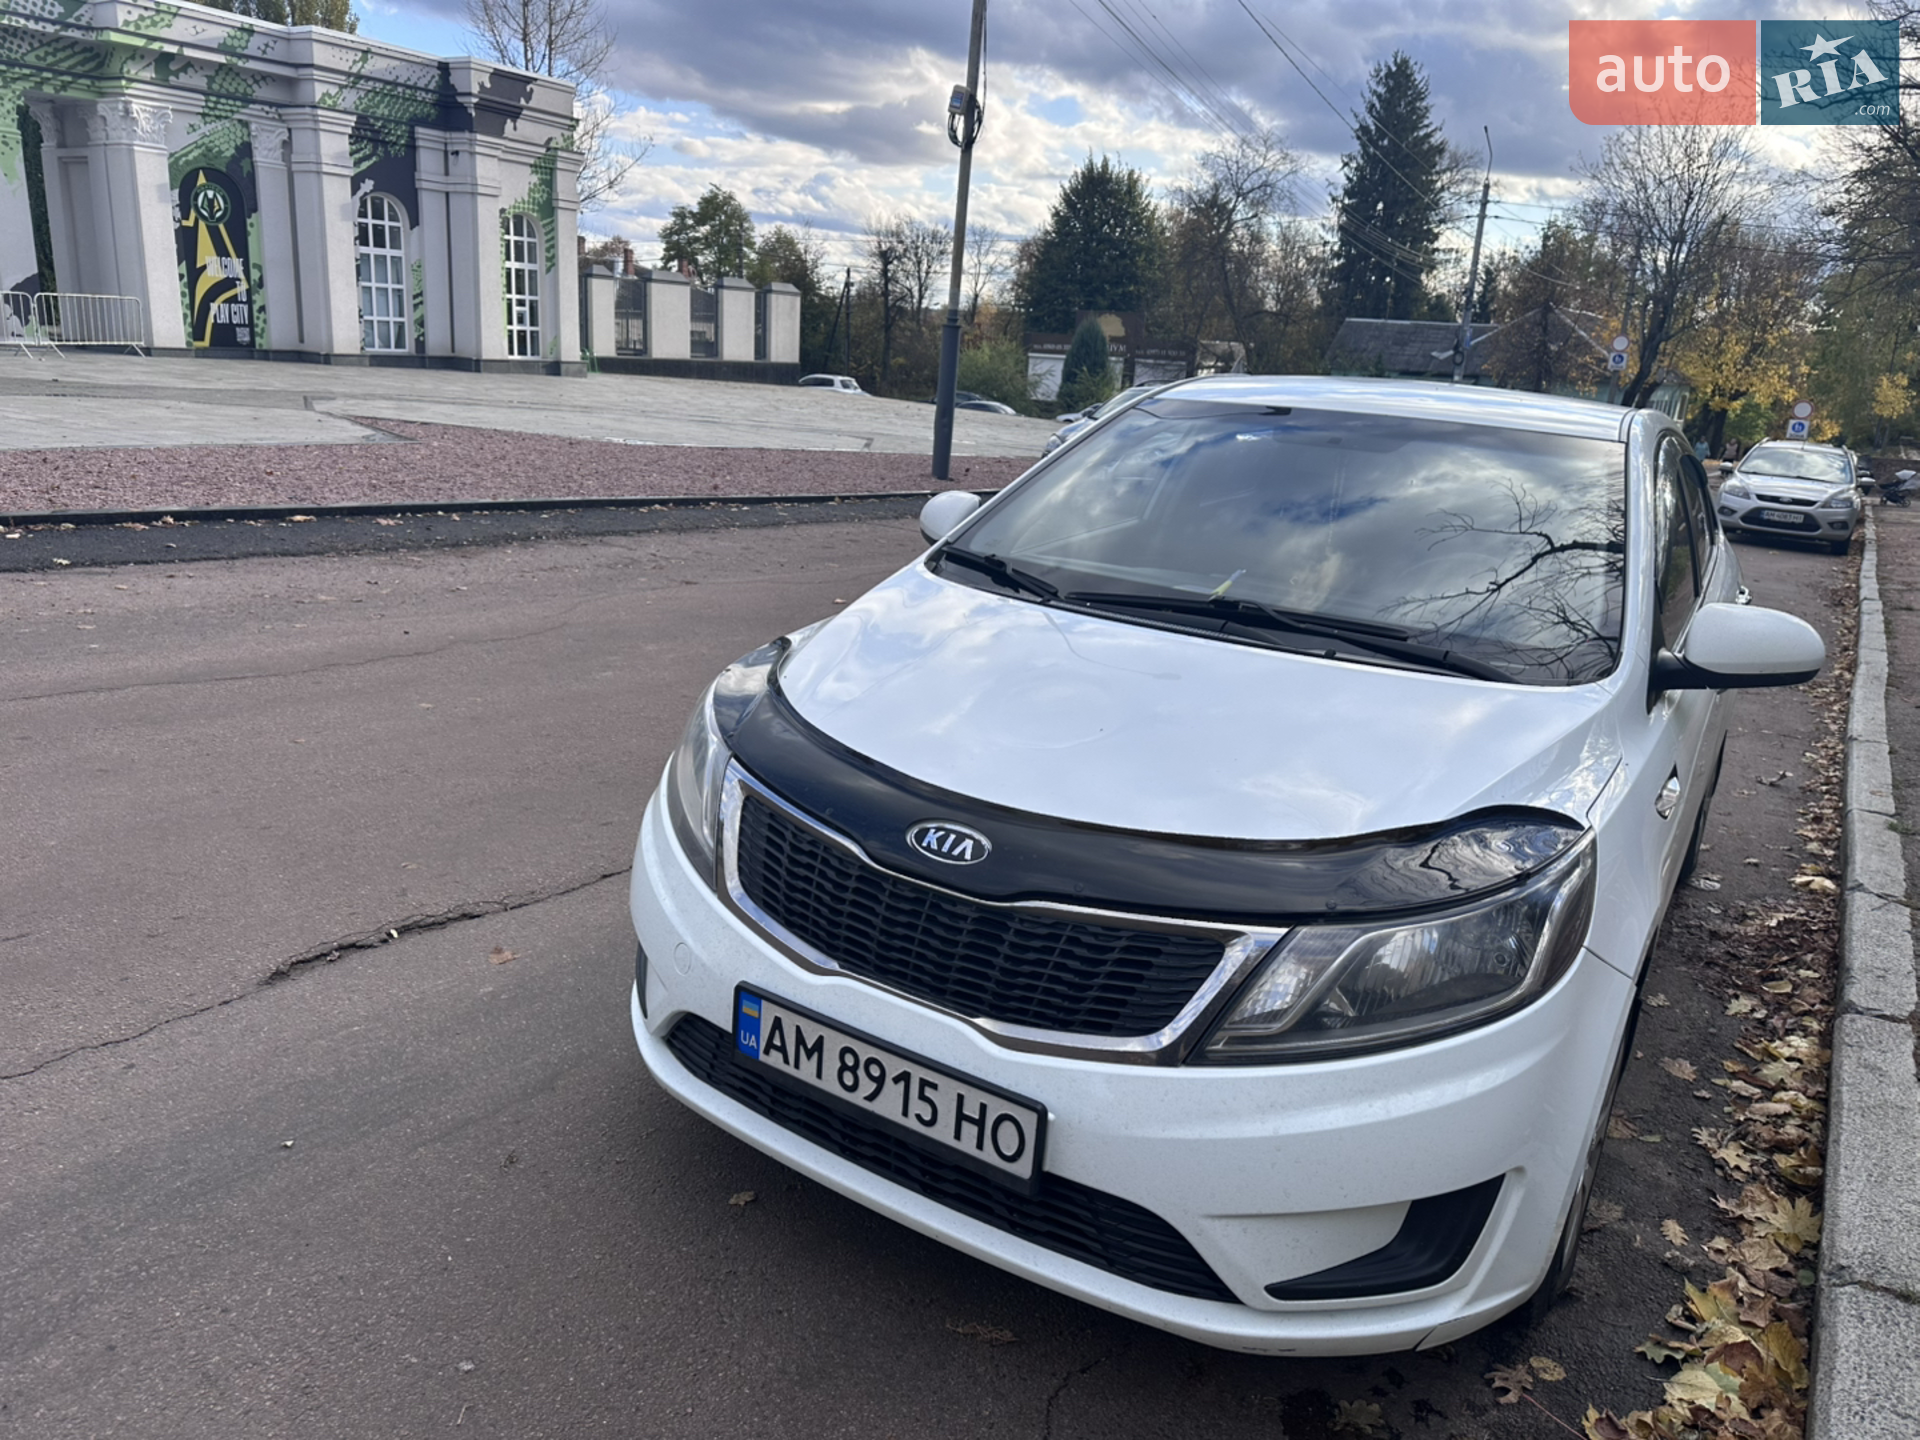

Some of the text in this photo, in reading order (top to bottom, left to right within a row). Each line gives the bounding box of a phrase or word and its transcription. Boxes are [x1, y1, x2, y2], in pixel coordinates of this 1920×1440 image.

[205, 255, 244, 278] WELCOME
[235, 281, 248, 302] TO
[210, 302, 249, 325] PLAY CITY
[921, 828, 974, 861] KIA
[740, 1029, 758, 1050] UA
[762, 1015, 1026, 1164] AM 8915 HO
